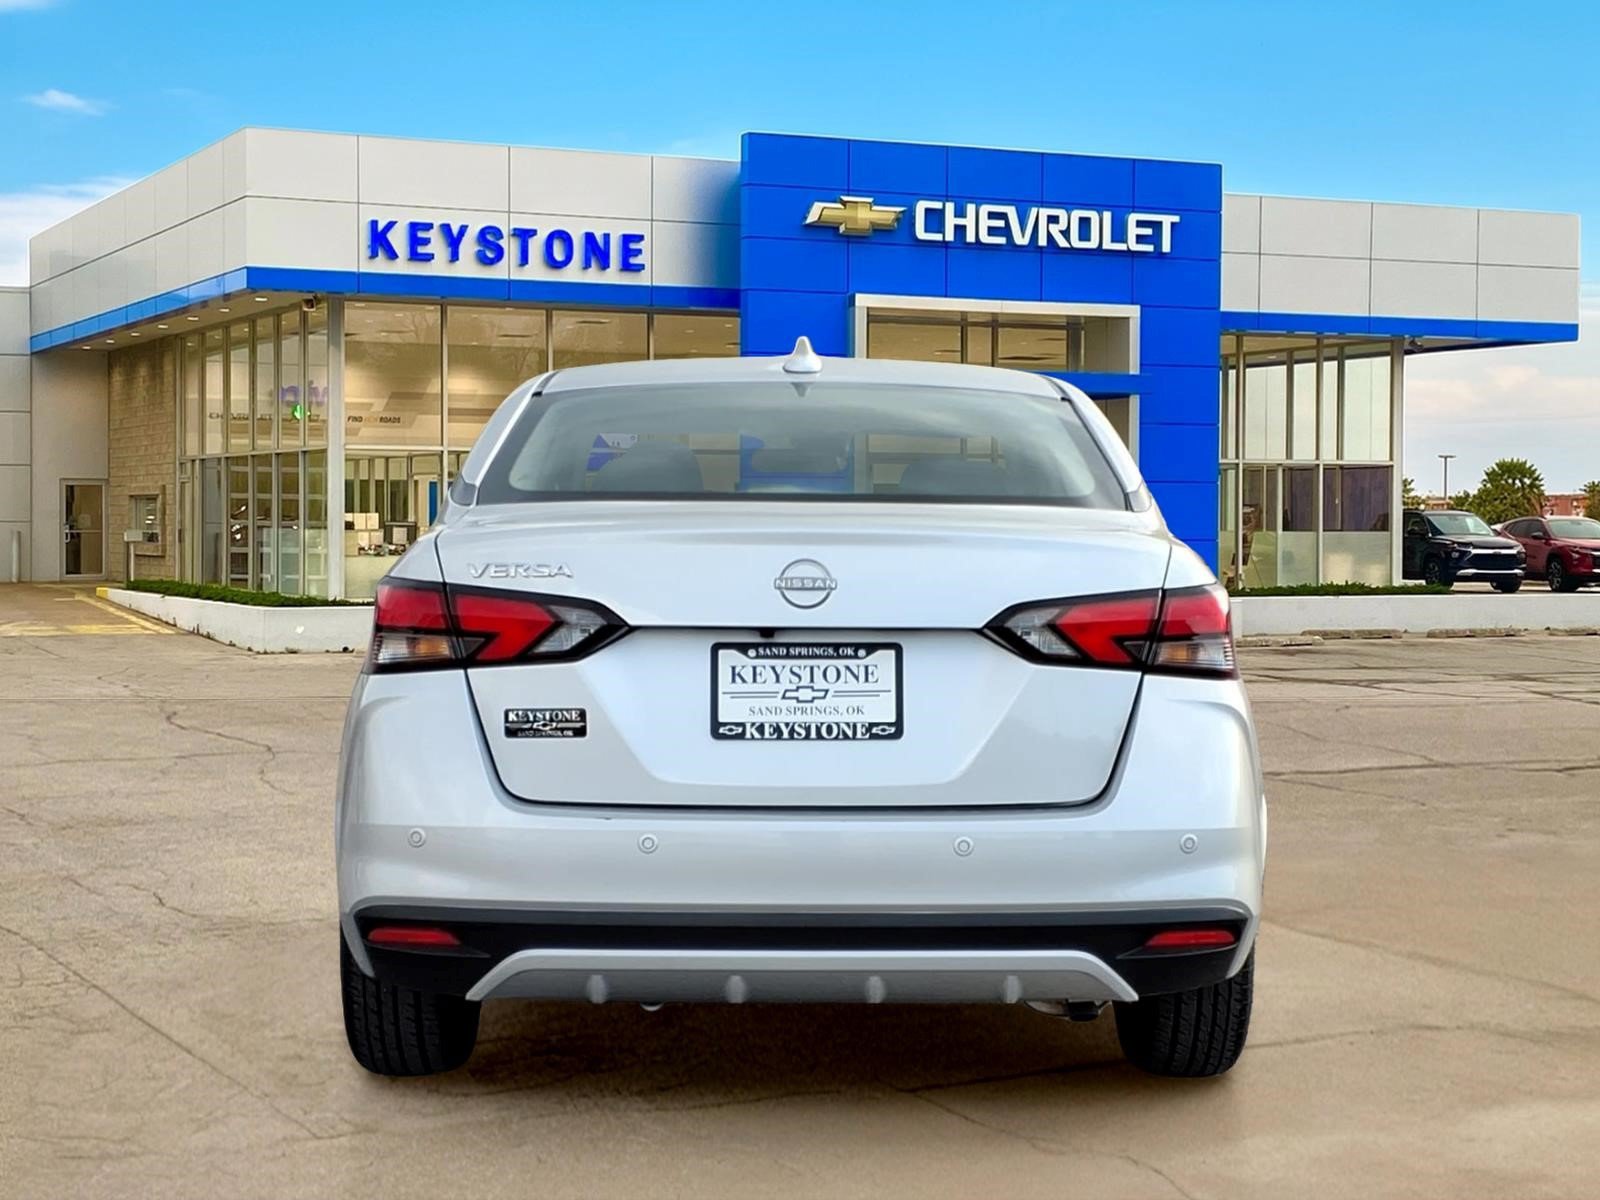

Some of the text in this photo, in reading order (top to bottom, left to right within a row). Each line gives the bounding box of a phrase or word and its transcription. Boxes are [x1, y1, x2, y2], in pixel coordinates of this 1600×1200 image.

[914, 199, 1181, 254] CHEVROLET
[368, 218, 646, 273] KEYSTONE
[467, 563, 574, 579] VERSA
[775, 579, 837, 589] NISSAN
[758, 646, 855, 657] SAND SPRINGS, OK
[730, 664, 880, 685] KEYSTONE
[508, 710, 581, 722] KEYSTONE
[748, 705, 865, 717] SAND SPRINGS, OK
[744, 722, 870, 739] KEYSTONE
